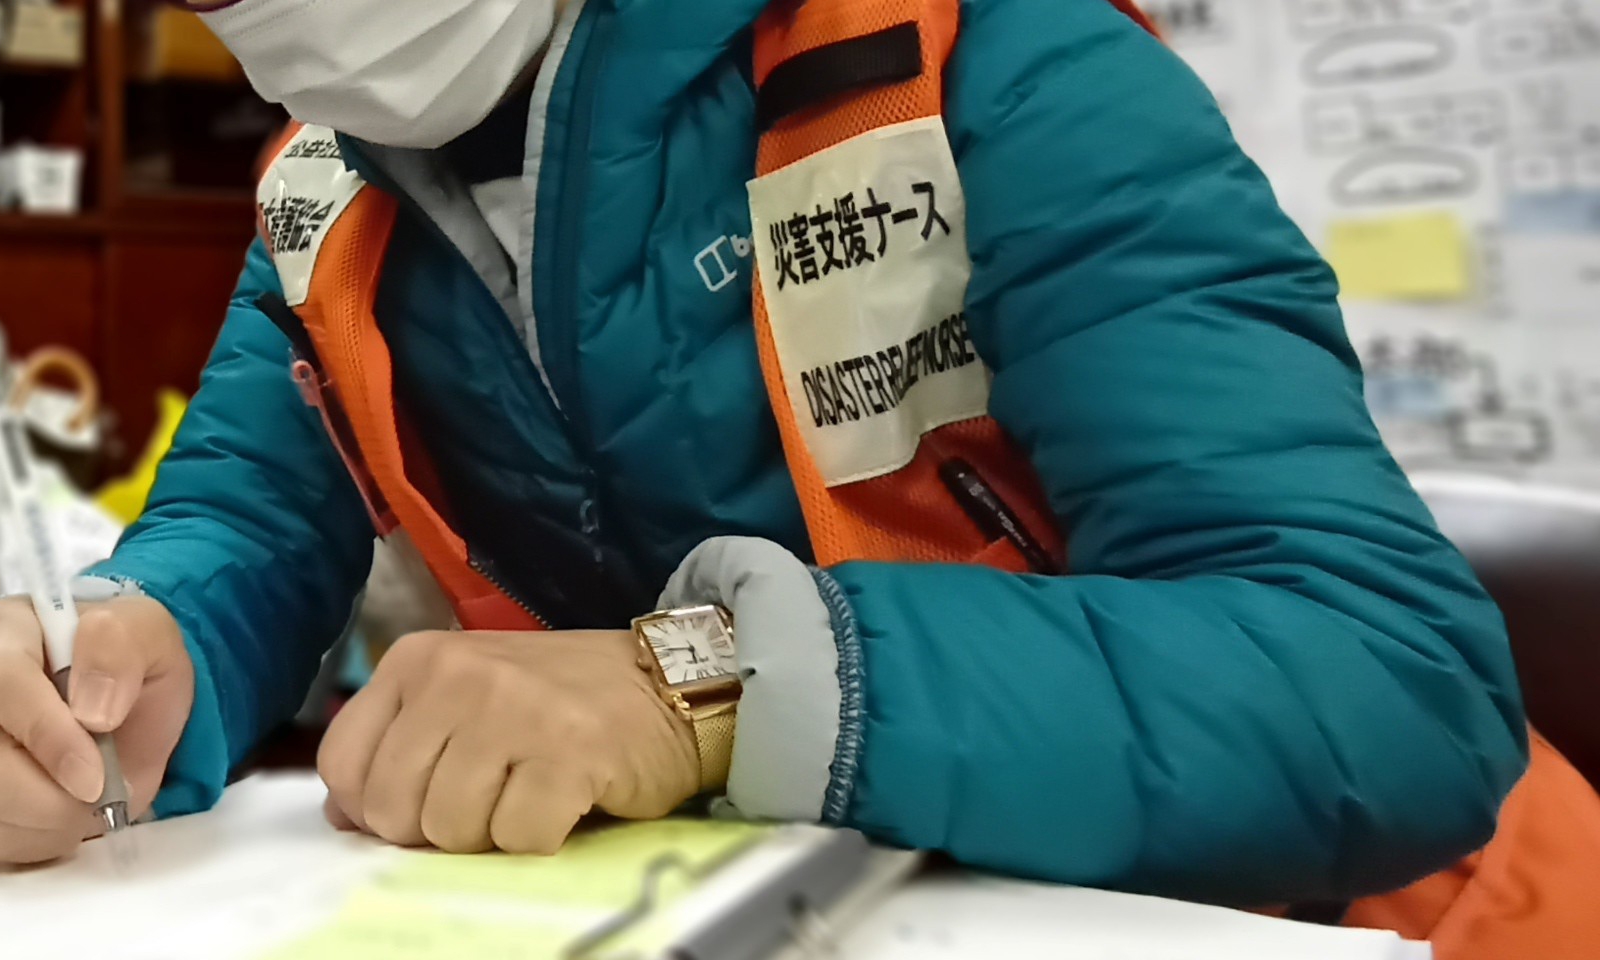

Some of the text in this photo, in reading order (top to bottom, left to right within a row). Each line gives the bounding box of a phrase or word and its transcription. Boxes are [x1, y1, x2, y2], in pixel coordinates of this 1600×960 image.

[770, 181, 950, 291] 災害支援ナース
